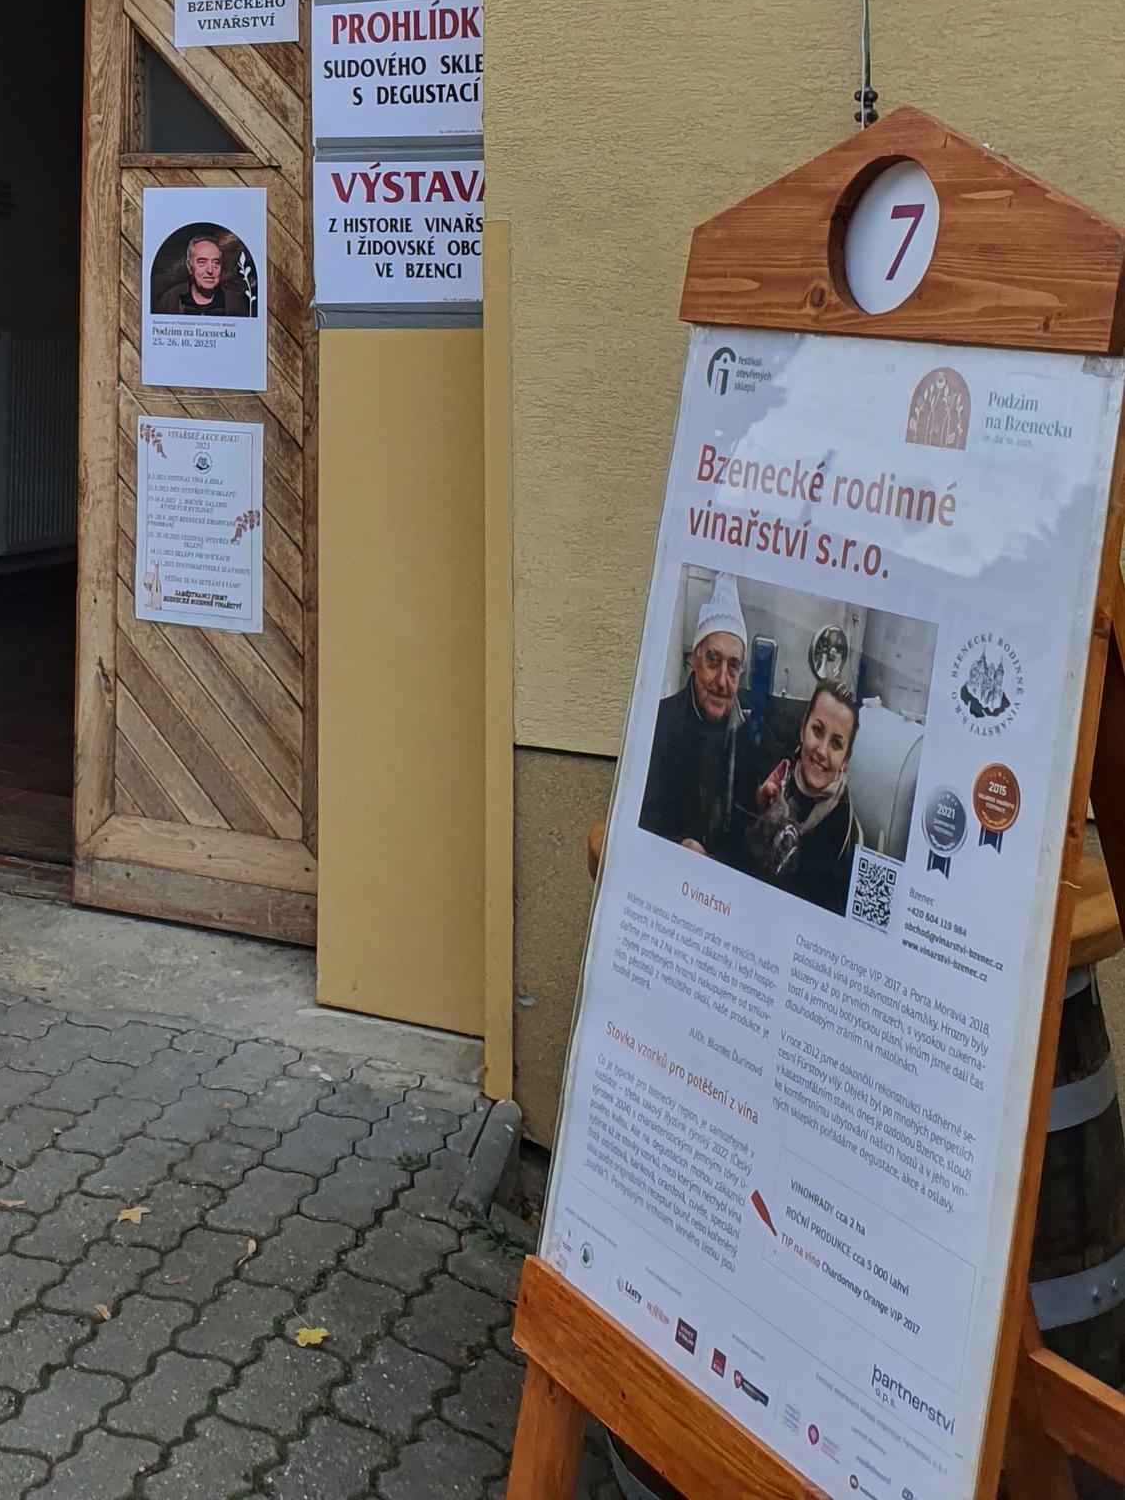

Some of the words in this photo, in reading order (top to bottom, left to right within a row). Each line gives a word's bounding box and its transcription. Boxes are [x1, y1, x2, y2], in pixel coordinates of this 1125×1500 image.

[197, 14, 275, 30] VINAŘSTVÍ
[331, 0, 484, 45] PROHLÍDK
[323, 52, 426, 79] SUDOVÉHO
[352, 87, 363, 106] S
[376, 77, 479, 106] DEGUSTACÍ
[328, 218, 338, 233] Z
[344, 217, 413, 234] HISTORIE
[424, 213, 483, 233] VINAŘS
[347, 240, 351, 256] I
[357, 235, 436, 256] ŽIDOVSKÉ
[447, 240, 482, 256] OBC
[885, 203, 925, 282] 7
[375, 263, 394, 279] VE
[405, 263, 462, 279] BZENCI
[152, 327, 181, 336] Podzim
[196, 328, 236, 338] Bzenecku
[738, 355, 762, 367] festival
[988, 391, 1038, 412] Podzim
[985, 415, 1001, 430] na
[1005, 415, 1073, 439] Bzenecku
[696, 443, 826, 503] Bzenecké
[833, 471, 957, 528] rodinné
[687, 502, 813, 562] vinařství
[814, 532, 890, 580] s.r.o.
[951, 632, 994, 679] BZENECKÉ
[997, 637, 1025, 695] RODINNÉ
[988, 781, 1007, 796] 2015
[937, 803, 955, 820] 2021
[681, 880, 689, 896] O
[690, 884, 731, 916] vinařství
[906, 904, 923, 919] +420
[925, 912, 938, 925] 604
[940, 918, 951, 931] 119
[909, 887, 934, 907] Bzenec
[901, 937, 987, 982] www.vinarstvi-bzenec.cz
[904, 921, 1003, 971] obchod@vinarstvi-bzenec.cz
[795, 933, 839, 965] Chardonnay
[840, 954, 867, 979] Orange
[868, 968, 882, 984] VIP
[883, 975, 900, 993] 2017
[910, 988, 931, 1008] Porta
[933, 998, 966, 1025] Moravia
[968, 1015, 990, 1038] 2018,
[790, 965, 818, 990] sklizeny
[820, 979, 828, 993] až
[830, 988, 840, 1000] po
[842, 991, 869, 1015] prvních
[871, 1005, 905, 1033] mrazech,
[913, 1026, 946, 1054] vysokou
[948, 1044, 985, 1072] cukerna-
[833, 969, 848, 985] vína
[849, 980, 861, 994] pro
[862, 983, 899, 1011] slavnostní
[900, 1002, 939, 1033] okamžiky.
[940, 1021, 969, 1048] Hrozny
[970, 1035, 988, 1057] byly
[784, 997, 834, 1034] dlouhodobým
[836, 1023, 862, 1046] zráním
[863, 1039, 873, 1052] na
[874, 1043, 919, 1077] matolinách.
[787, 981, 803, 999] tostí
[809, 994, 837, 1018] jemnou
[838, 1007, 880, 1040] botrytickou
[904, 1040, 929, 1063] vínům
[930, 1054, 950, 1077] jsme
[952, 1064, 968, 1083] dali
[969, 1073, 984, 1091] čas
[605, 1019, 635, 1050] Stovka
[637, 1038, 668, 1069] vzorků
[668, 1059, 685, 1082] pro
[686, 1067, 728, 1108] potěšení
[729, 1095, 735, 1109] z
[736, 1097, 759, 1125] vína
[790, 1178, 834, 1216] VINOHRADY
[835, 1209, 847, 1225] cca
[849, 1217, 854, 1229] 2
[855, 1220, 865, 1236] ha
[785, 1202, 810, 1230] ROČNÍ
[810, 1221, 852, 1258] PRODUKCE
[852, 1251, 865, 1267] cca
[866, 1259, 871, 1272] 5
[873, 1263, 888, 1282] 000
[889, 1272, 909, 1297] lahví
[780, 1232, 793, 1249] TIP
[793, 1243, 803, 1256] na
[804, 1248, 820, 1268] víno
[821, 1259, 862, 1299] Chardonnay
[863, 1289, 888, 1317] Orange
[889, 1306, 902, 1324] VIP
[903, 1316, 920, 1336] 2017
[872, 1362, 955, 1437] partnerství
